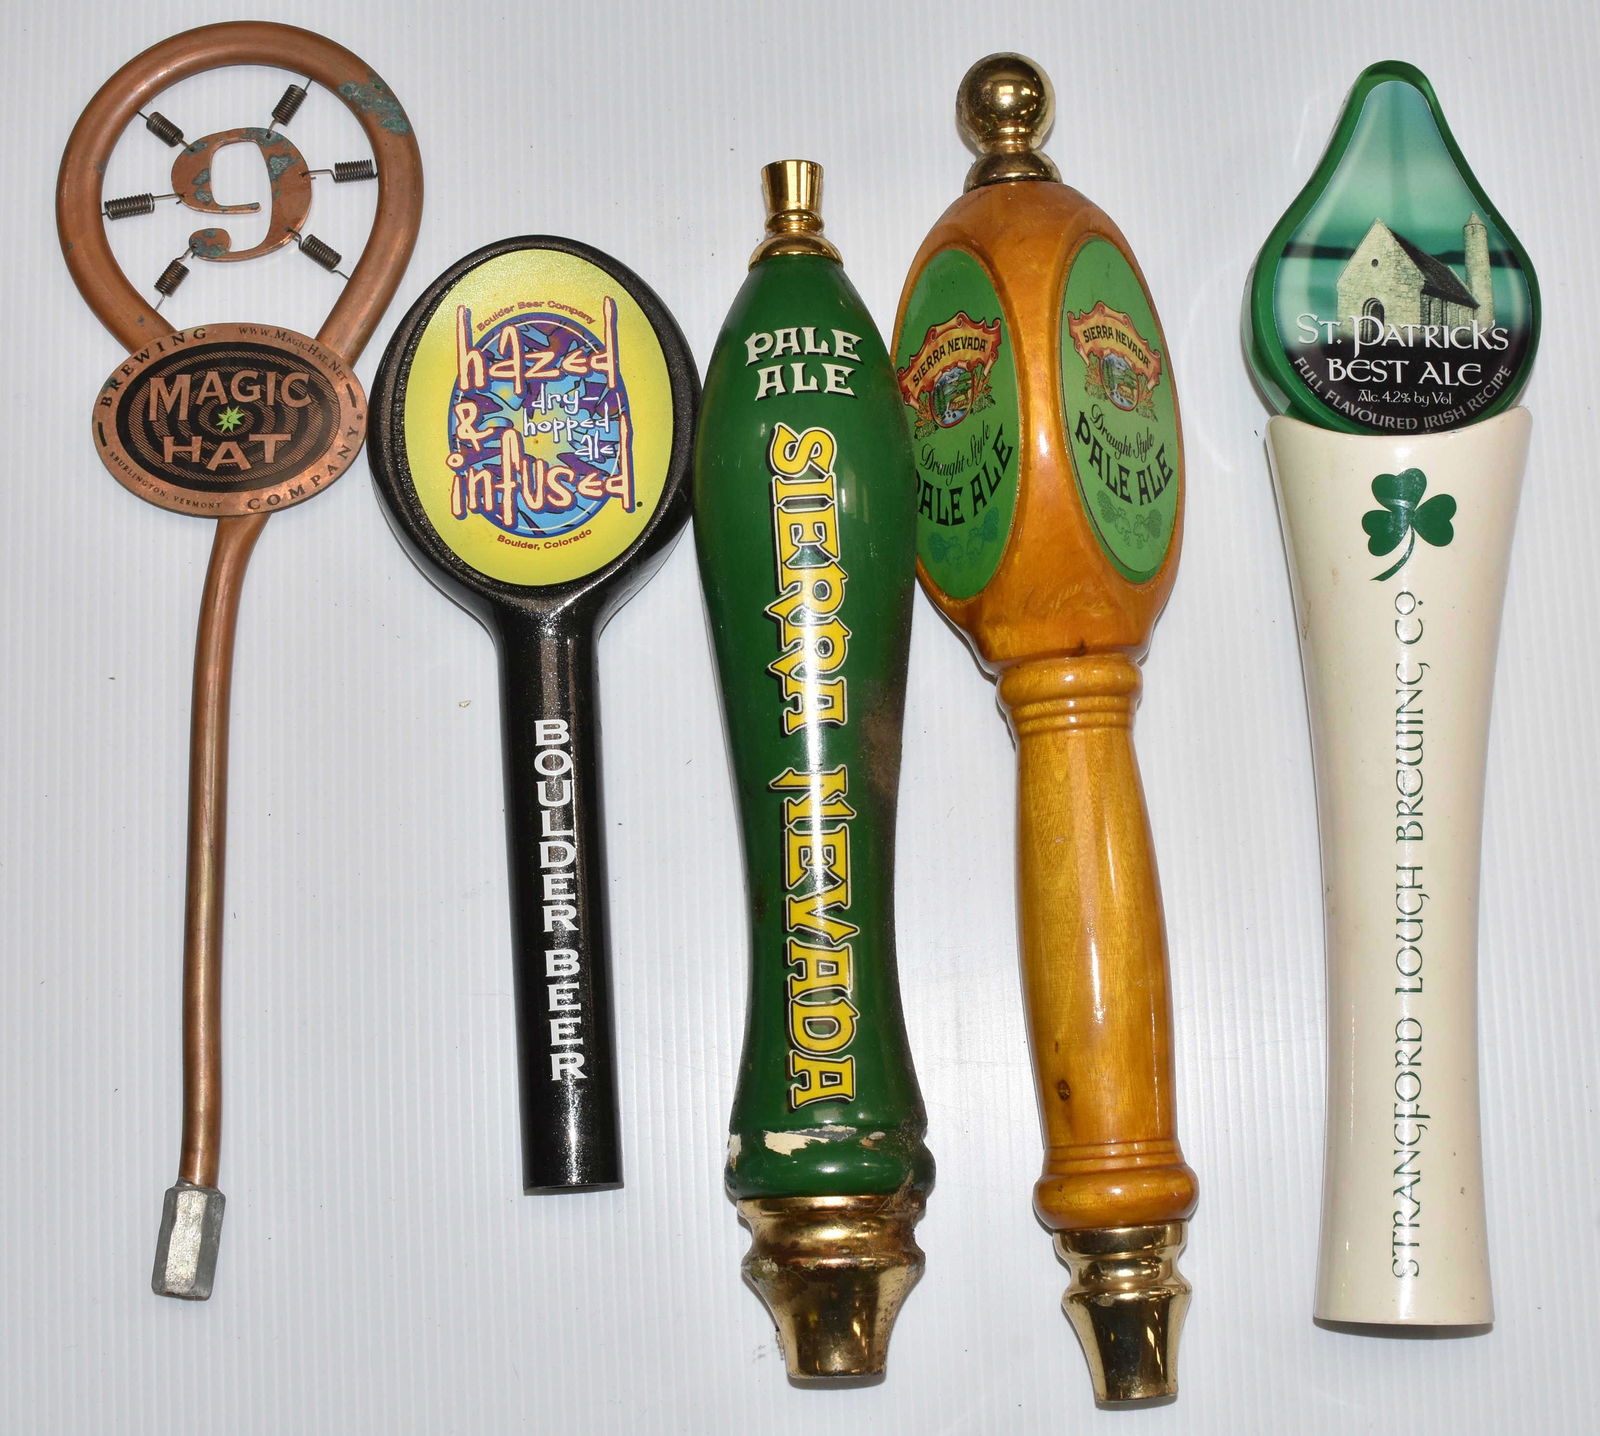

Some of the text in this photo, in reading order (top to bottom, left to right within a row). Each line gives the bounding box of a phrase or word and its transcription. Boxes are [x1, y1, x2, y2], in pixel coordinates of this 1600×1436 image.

[476, 300, 596, 332] Boulder Beer Company
[101, 328, 208, 408] BREWING
[744, 326, 863, 368] PALE
[912, 336, 987, 388] SIERRA NEVADA
[1083, 328, 1152, 366] SIERRA NEVADA
[1326, 357, 1483, 387] BEST ALE
[149, 369, 312, 421] MAGIC
[755, 362, 858, 401] ALE
[1294, 356, 1512, 431] FULL FLAVOURED IRISH RECIPE
[1358, 389, 1452, 407] Alc. 4.2% by Vol
[453, 400, 494, 452] &
[523, 402, 610, 443] hopped
[574, 430, 615, 461] ale
[1090, 404, 1155, 463] Draught Style
[163, 433, 292, 471] HAT
[246, 426, 360, 511] COMPANY
[919, 419, 990, 486] Draught Style
[970, 423, 1014, 516] ALE
[1074, 411, 1174, 506] PALE ALE
[173, 495, 222, 509] VERMONT
[496, 528, 593, 551] Boulder, Colorado
[764, 421, 861, 1110] SIERRA NEVADA
[534, 719, 588, 1081] BOULDER BEER
[1391, 590, 1432, 1279] STRANGFORD LOUGH BREWING CO.
